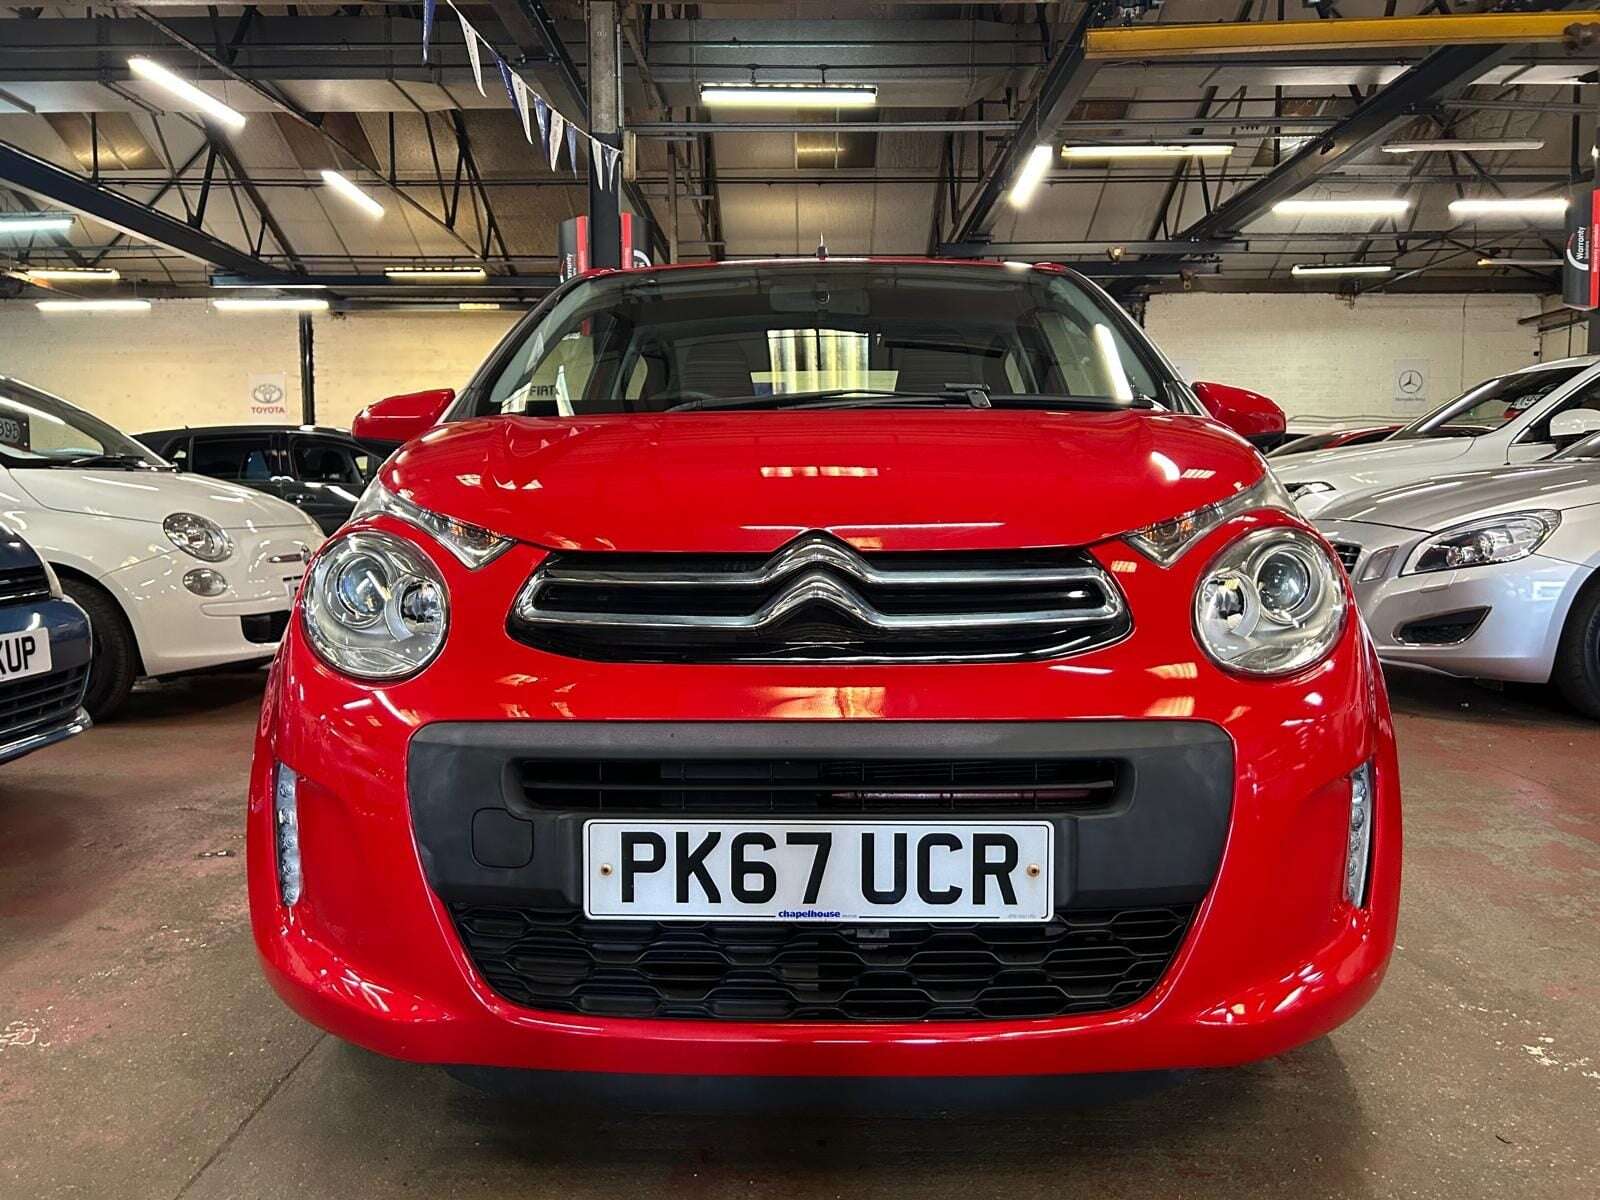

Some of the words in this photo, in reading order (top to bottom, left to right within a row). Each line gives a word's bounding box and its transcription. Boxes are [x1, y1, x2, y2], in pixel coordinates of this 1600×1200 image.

[1576, 226, 1586, 260] Warranty
[250, 406, 285, 414] TOYOTA
[620, 831, 832, 904] PK67
[861, 832, 1019, 905] UCR
[778, 909, 841, 919] chapelhouse
